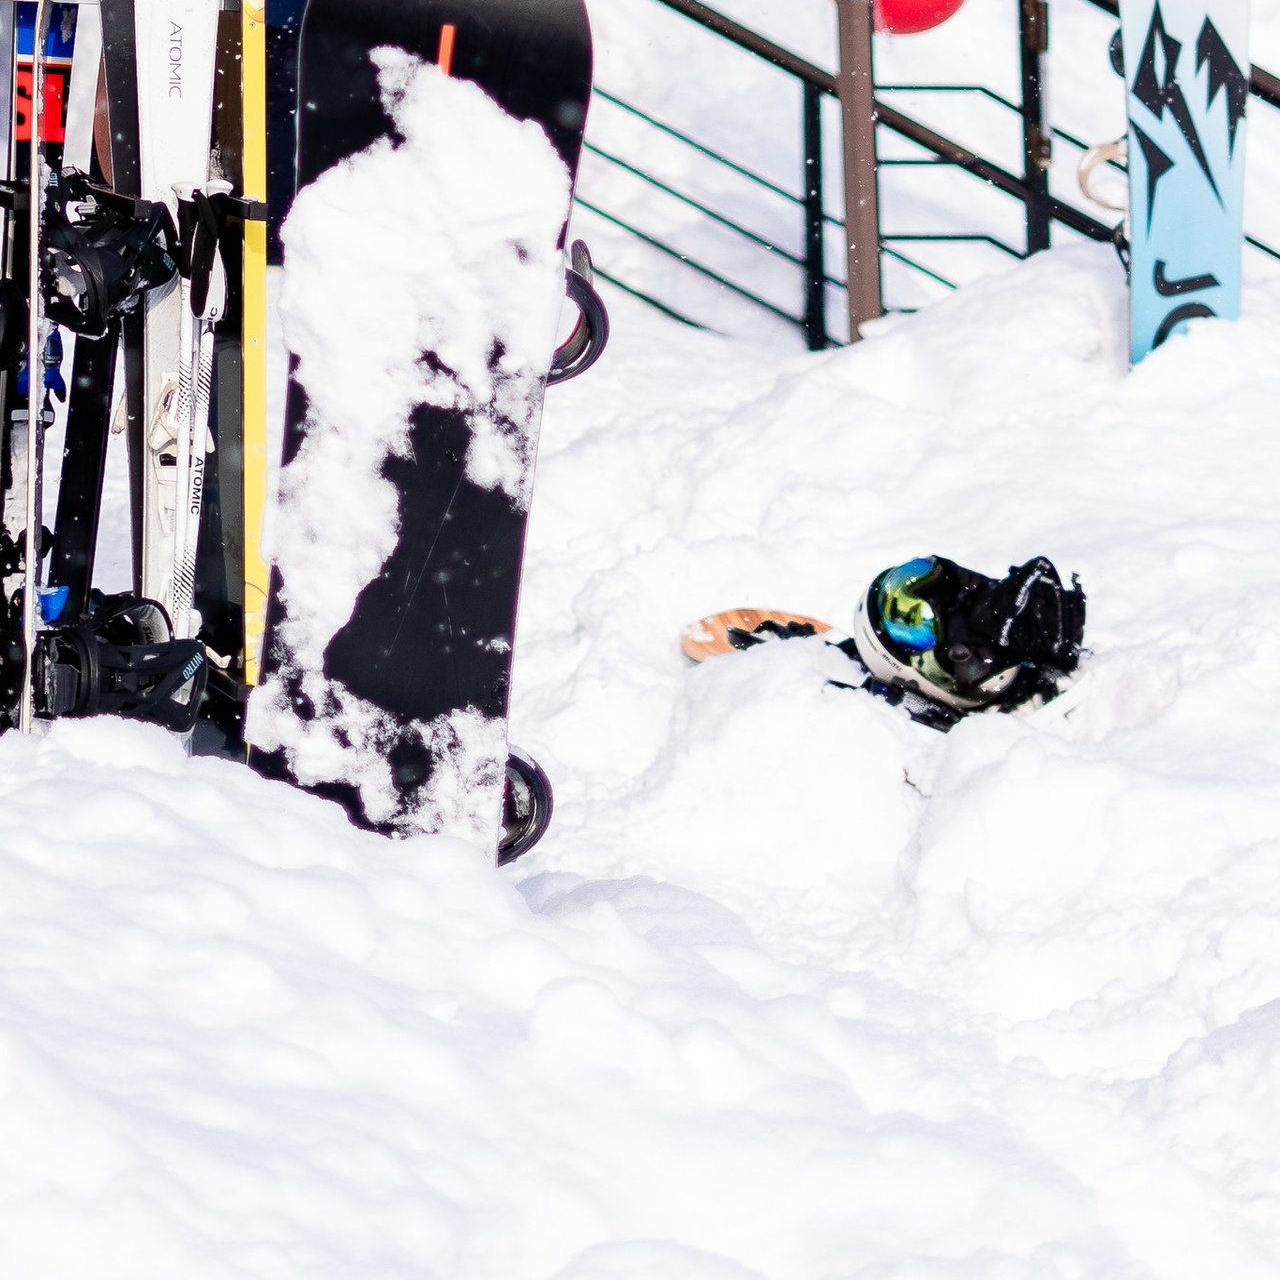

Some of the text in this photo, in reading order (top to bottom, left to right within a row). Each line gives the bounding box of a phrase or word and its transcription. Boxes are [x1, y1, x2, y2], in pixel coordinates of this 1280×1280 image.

[167, 20, 182, 98] ATOMIC
[191, 456, 204, 515] ATOMIC
[182, 653, 204, 680] NITRO
